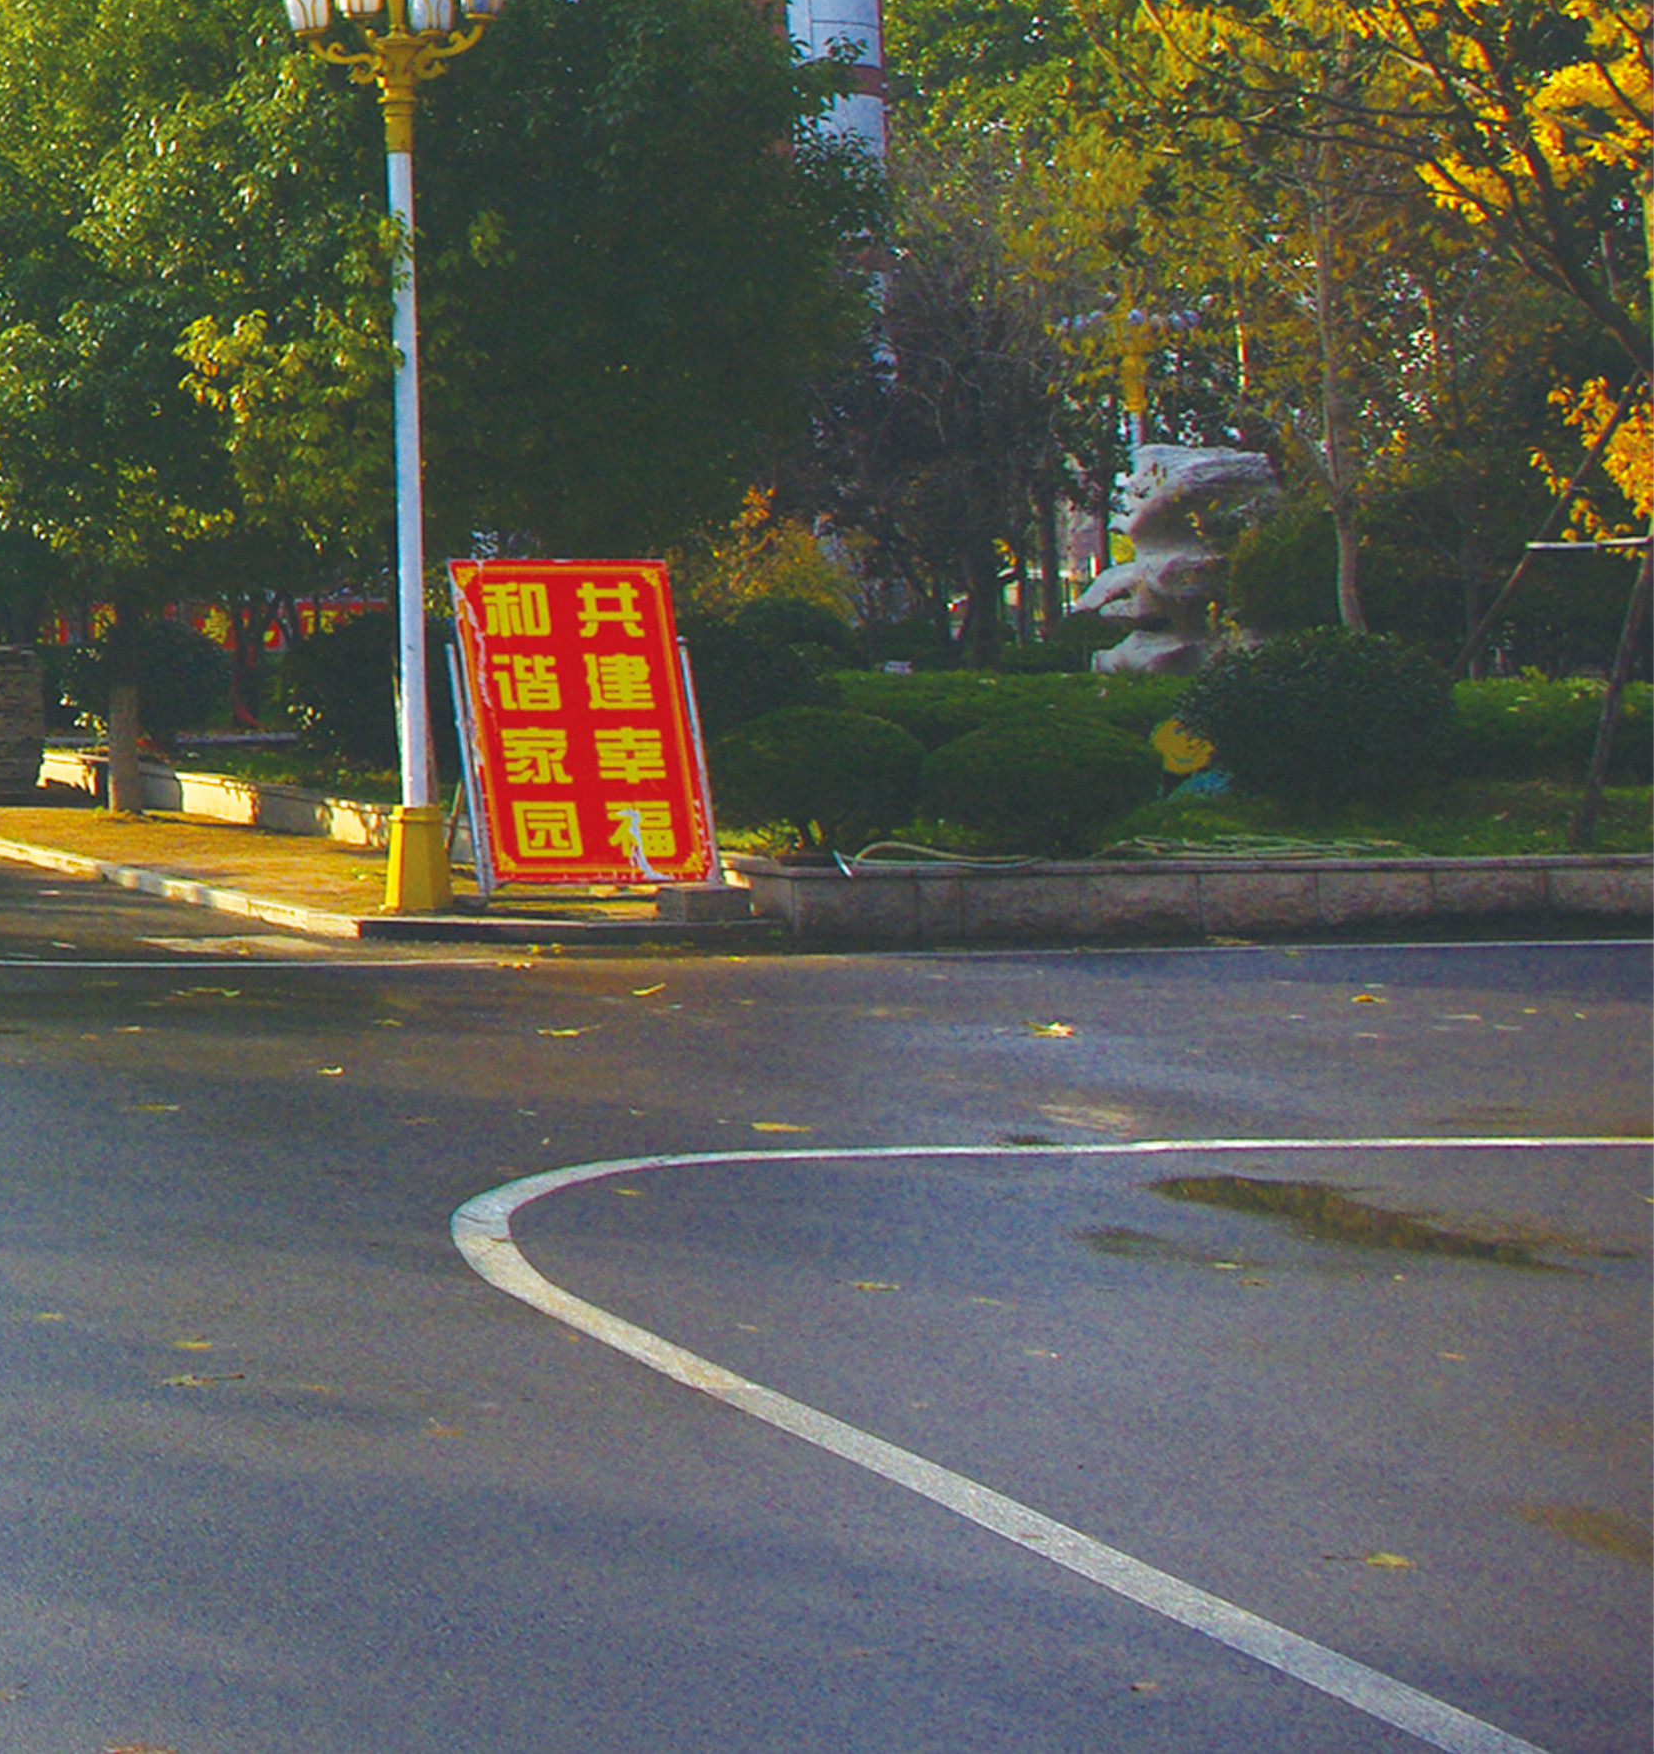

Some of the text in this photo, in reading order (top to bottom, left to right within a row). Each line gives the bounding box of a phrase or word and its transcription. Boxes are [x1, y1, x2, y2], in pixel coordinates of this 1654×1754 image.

[481, 582, 584, 858] 和谐家园
[576, 582, 677, 858] 共建幸福
